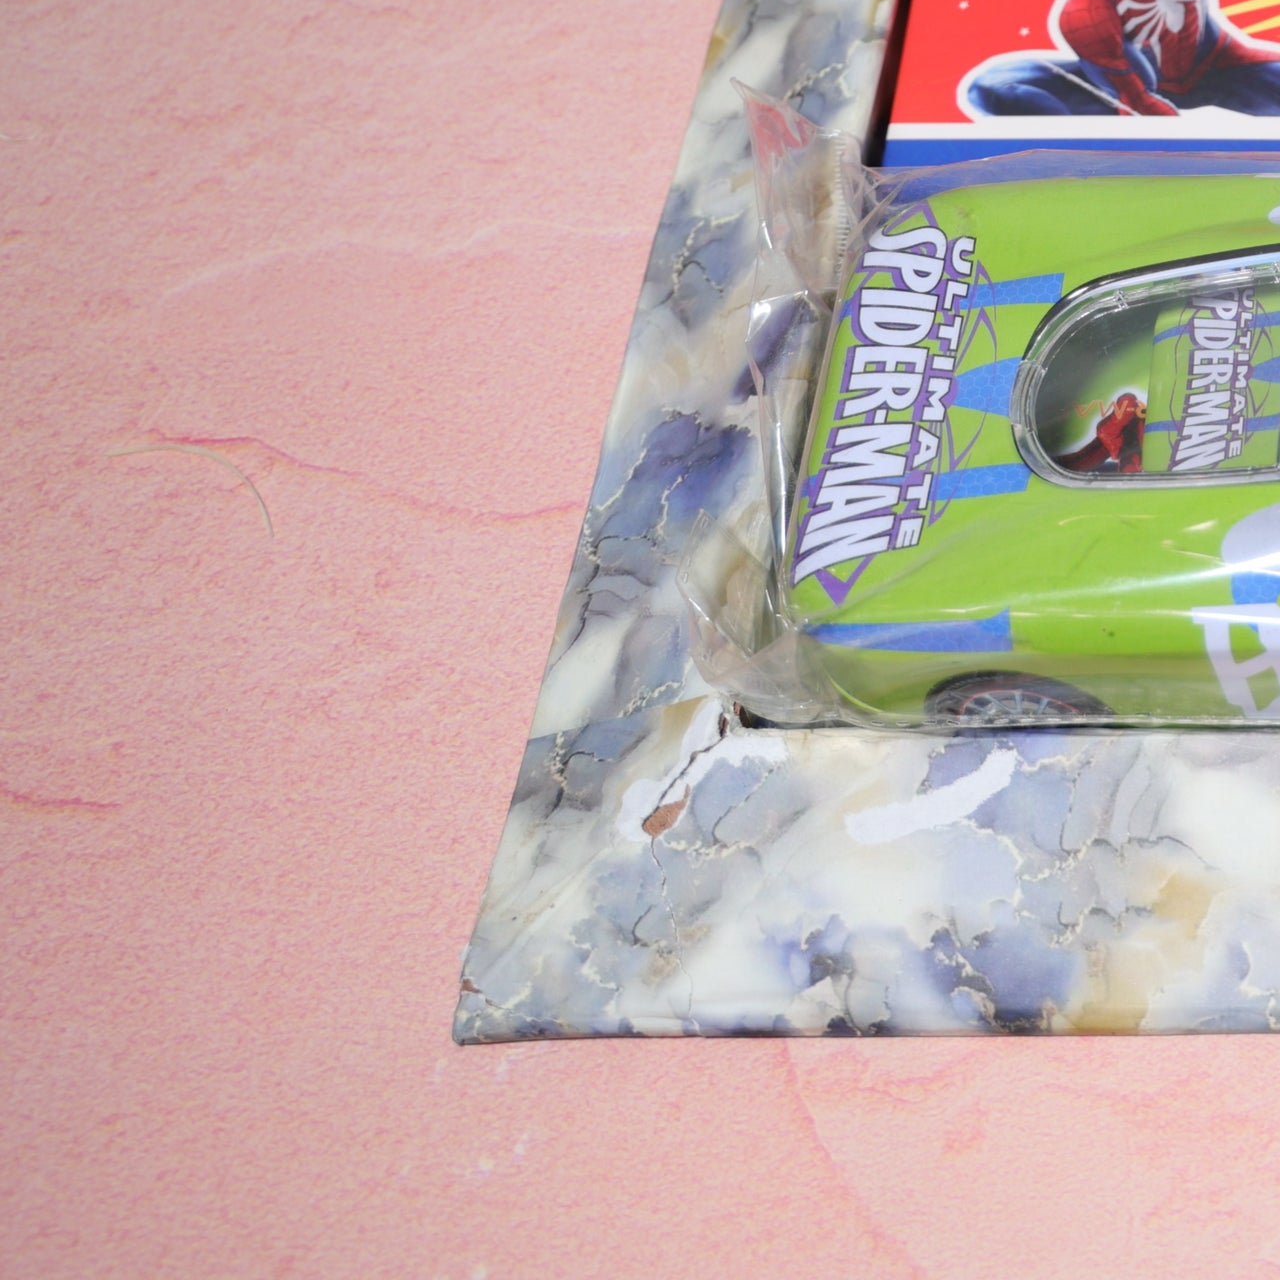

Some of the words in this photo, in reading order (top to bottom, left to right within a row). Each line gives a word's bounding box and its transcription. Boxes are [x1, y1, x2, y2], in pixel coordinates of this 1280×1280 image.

[793, 225, 948, 587] SPIDER-MAN
[894, 235, 977, 551] ULTIMATE
[1228, 288, 1255, 458] ULTIMATE
